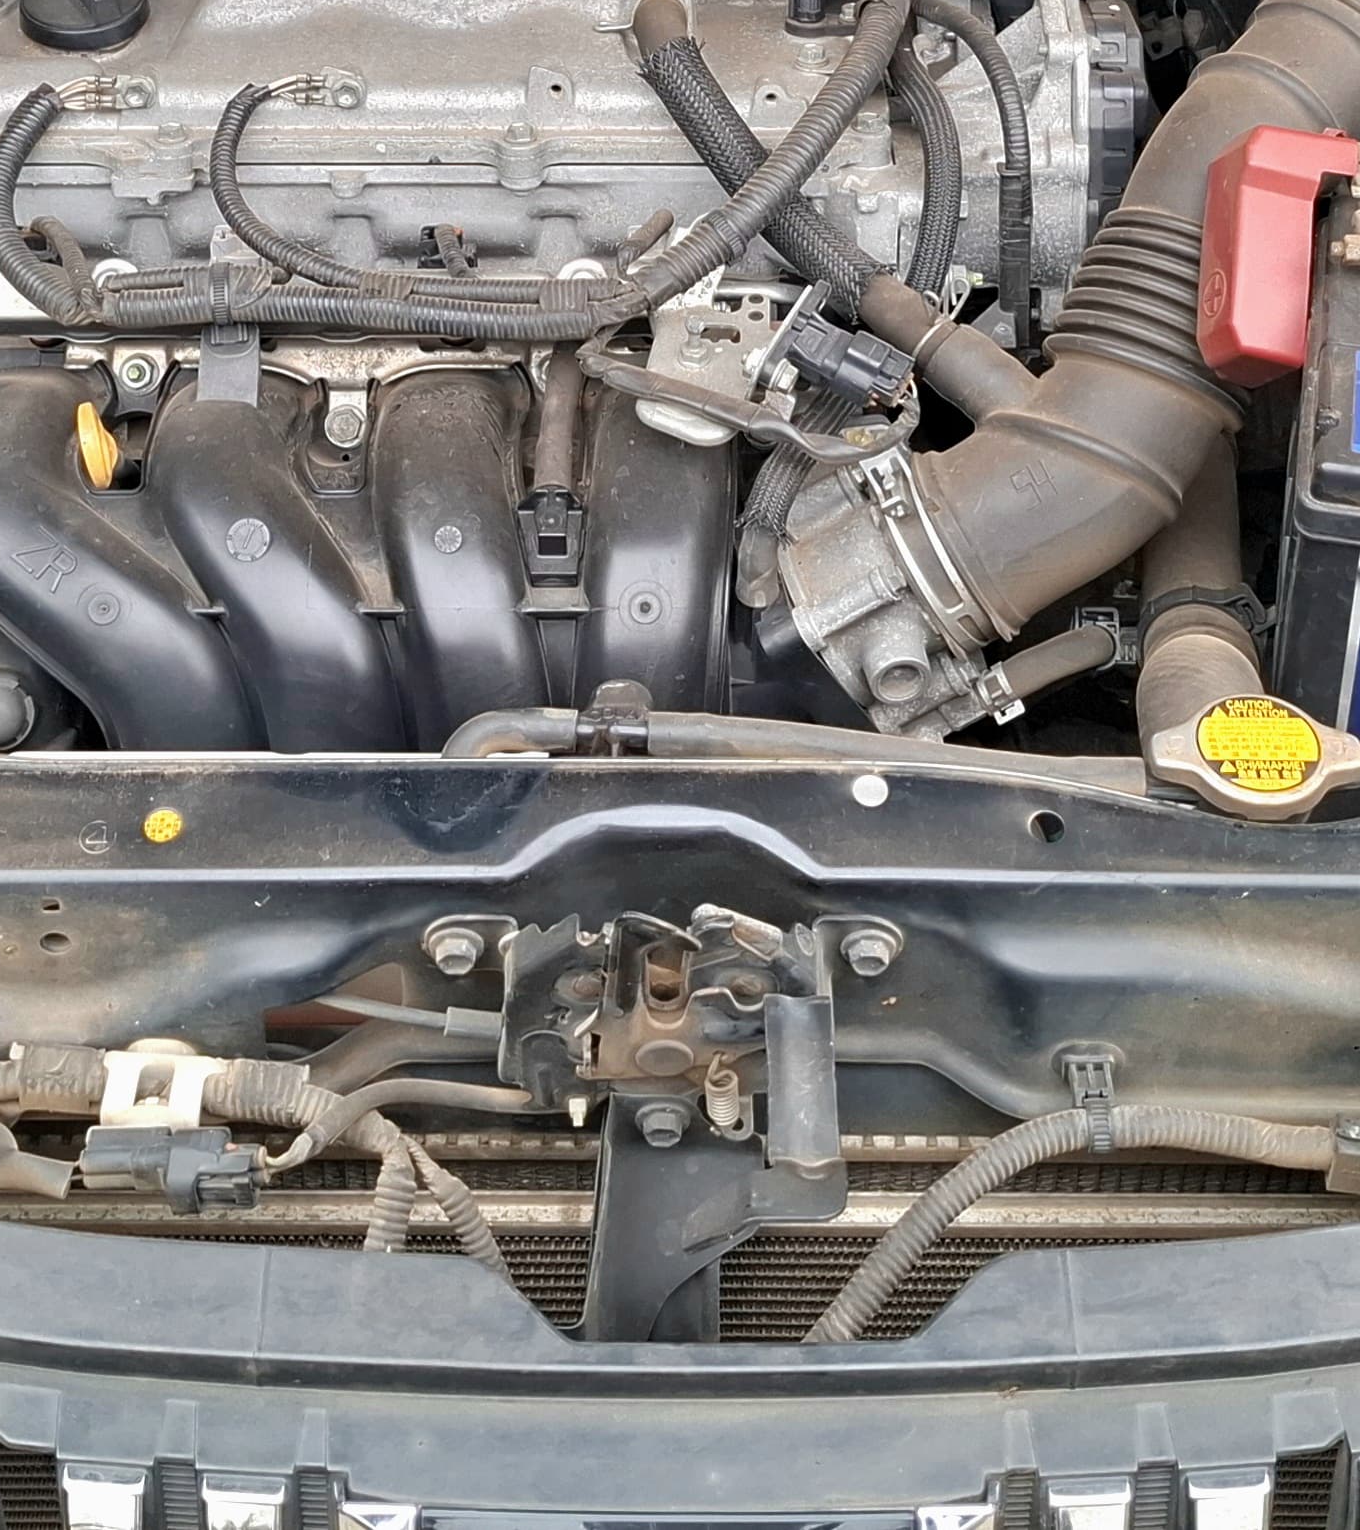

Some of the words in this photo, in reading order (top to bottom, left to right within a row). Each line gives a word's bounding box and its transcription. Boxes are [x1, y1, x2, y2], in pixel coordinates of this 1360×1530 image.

[10, 525, 78, 594] ZR
[1226, 700, 1274, 710] CAUTION
[1229, 709, 1288, 719] ATTENTION
